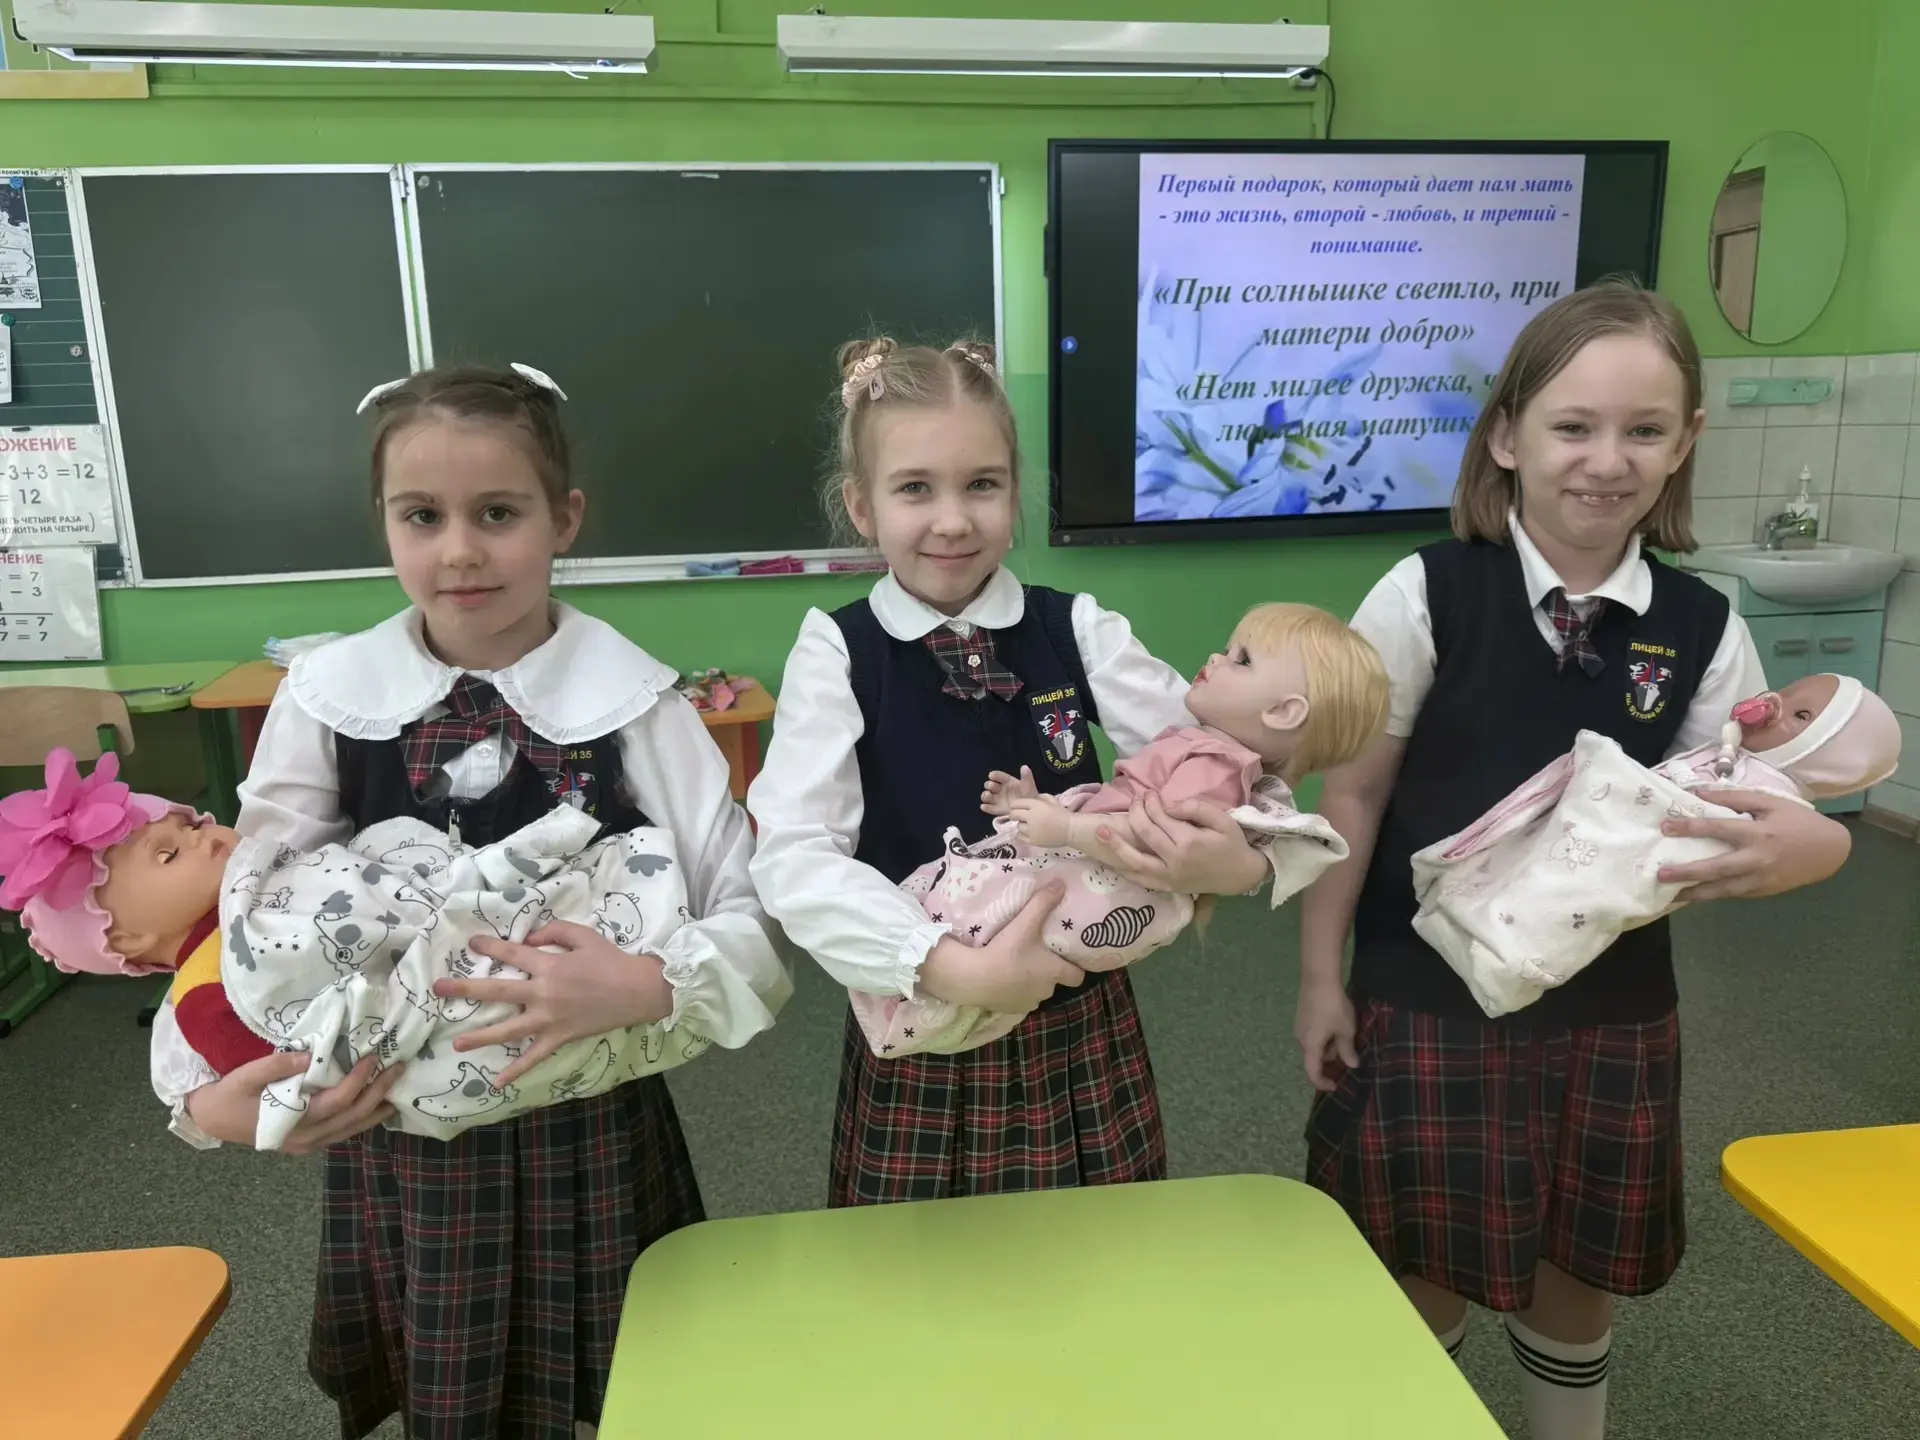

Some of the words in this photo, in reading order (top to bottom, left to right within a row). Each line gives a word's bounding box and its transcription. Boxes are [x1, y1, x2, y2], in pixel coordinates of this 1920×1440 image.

[1158, 174, 1235, 197] Первый
[1241, 175, 1327, 197] подарок,
[1333, 175, 1420, 197] который
[1426, 173, 1474, 192] дает
[1479, 179, 1516, 192] нам
[1520, 179, 1573, 192] мать
[1173, 209, 1210, 223] это
[1216, 209, 1287, 225] жизнь,
[1293, 205, 1366, 227] второй
[1383, 204, 1457, 225] любовь,
[1463, 208, 1475, 222] и
[1480, 204, 1557, 226] третий
[1310, 239, 1423, 254] понимание.
[1155, 278, 1232, 311] «При
[1242, 282, 1388, 302] солнышке
[1396, 280, 1501, 302] светло,
[1511, 279, 1561, 305] при
[1256, 326, 1371, 351] матери
[1380, 317, 1475, 349] добро»
[1176, 373, 1256, 400] «Нет
[1264, 377, 1354, 398] милее
[1360, 370, 1473, 400] дружка,
[19, 488, 42, 504] 12
[21, 516, 57, 524] ЧЕТЫРЕ
[59, 515, 82, 523] РАЗА
[40, 525, 52, 533] НА
[30, 571, 39, 582] 7
[32, 586, 42, 597] 3
[36, 616, 46, 627] 7
[39, 631, 48, 641] 7
[1630, 642, 1664, 654] ЛИЦЕЙ
[1665, 648, 1676, 657] 35
[1031, 689, 1064, 706] ЛИЦЕЙ
[1065, 688, 1076, 698] 35
[579, 750, 593, 759] 35
